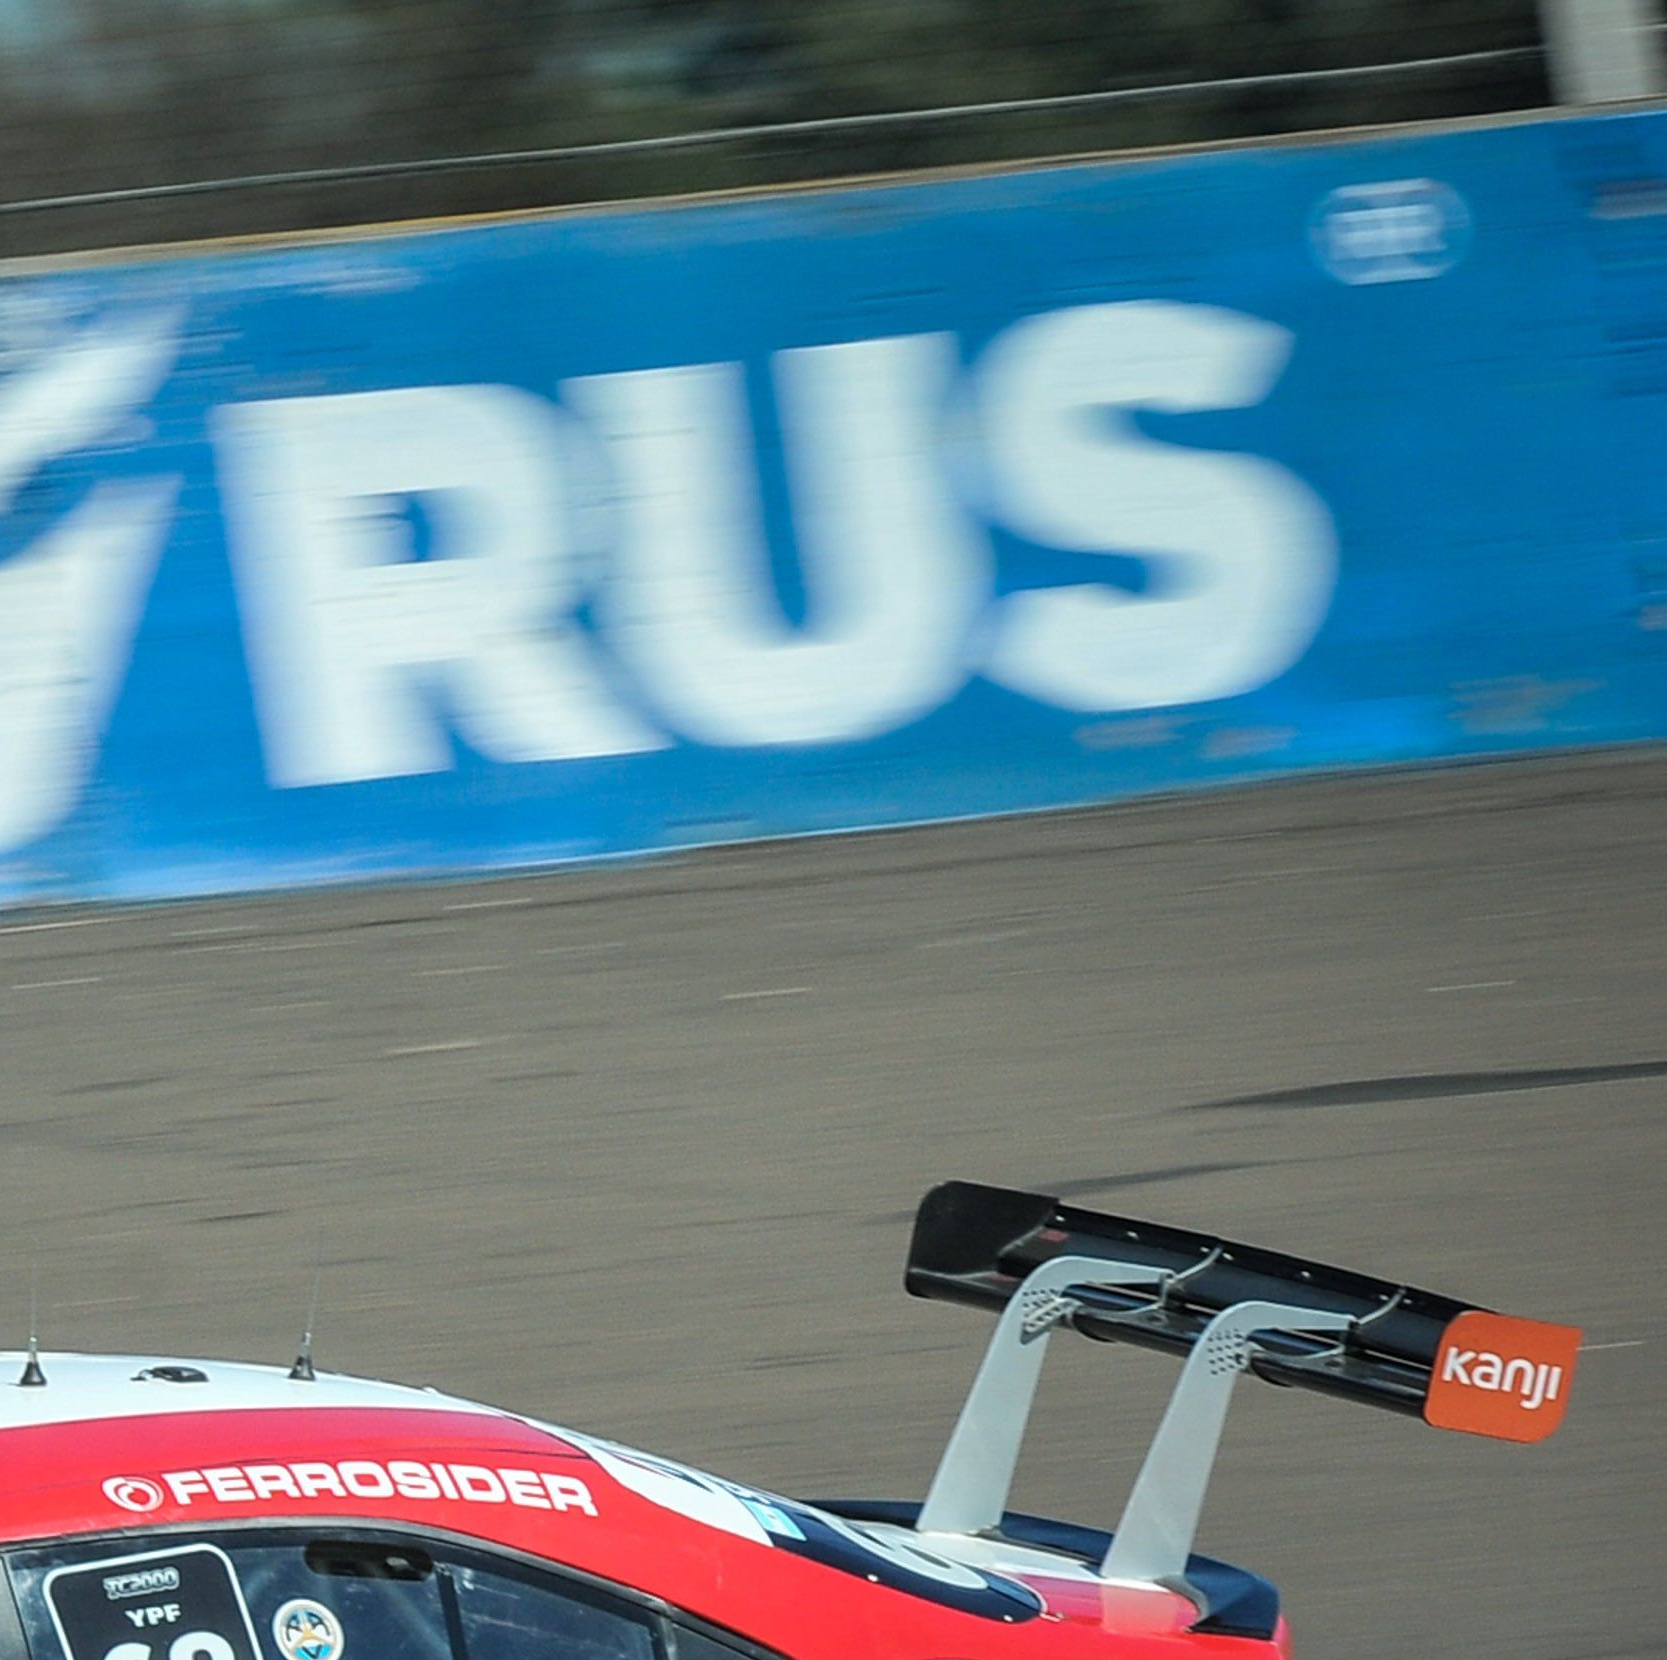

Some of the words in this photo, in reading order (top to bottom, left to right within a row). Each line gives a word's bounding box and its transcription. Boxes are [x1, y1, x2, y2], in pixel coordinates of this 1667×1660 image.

[209, 297, 1341, 791] RUS
[162, 1460, 598, 1516] FERROSIDER
[104, 1567, 179, 1599] TC2000
[125, 1604, 181, 1627] YPF
